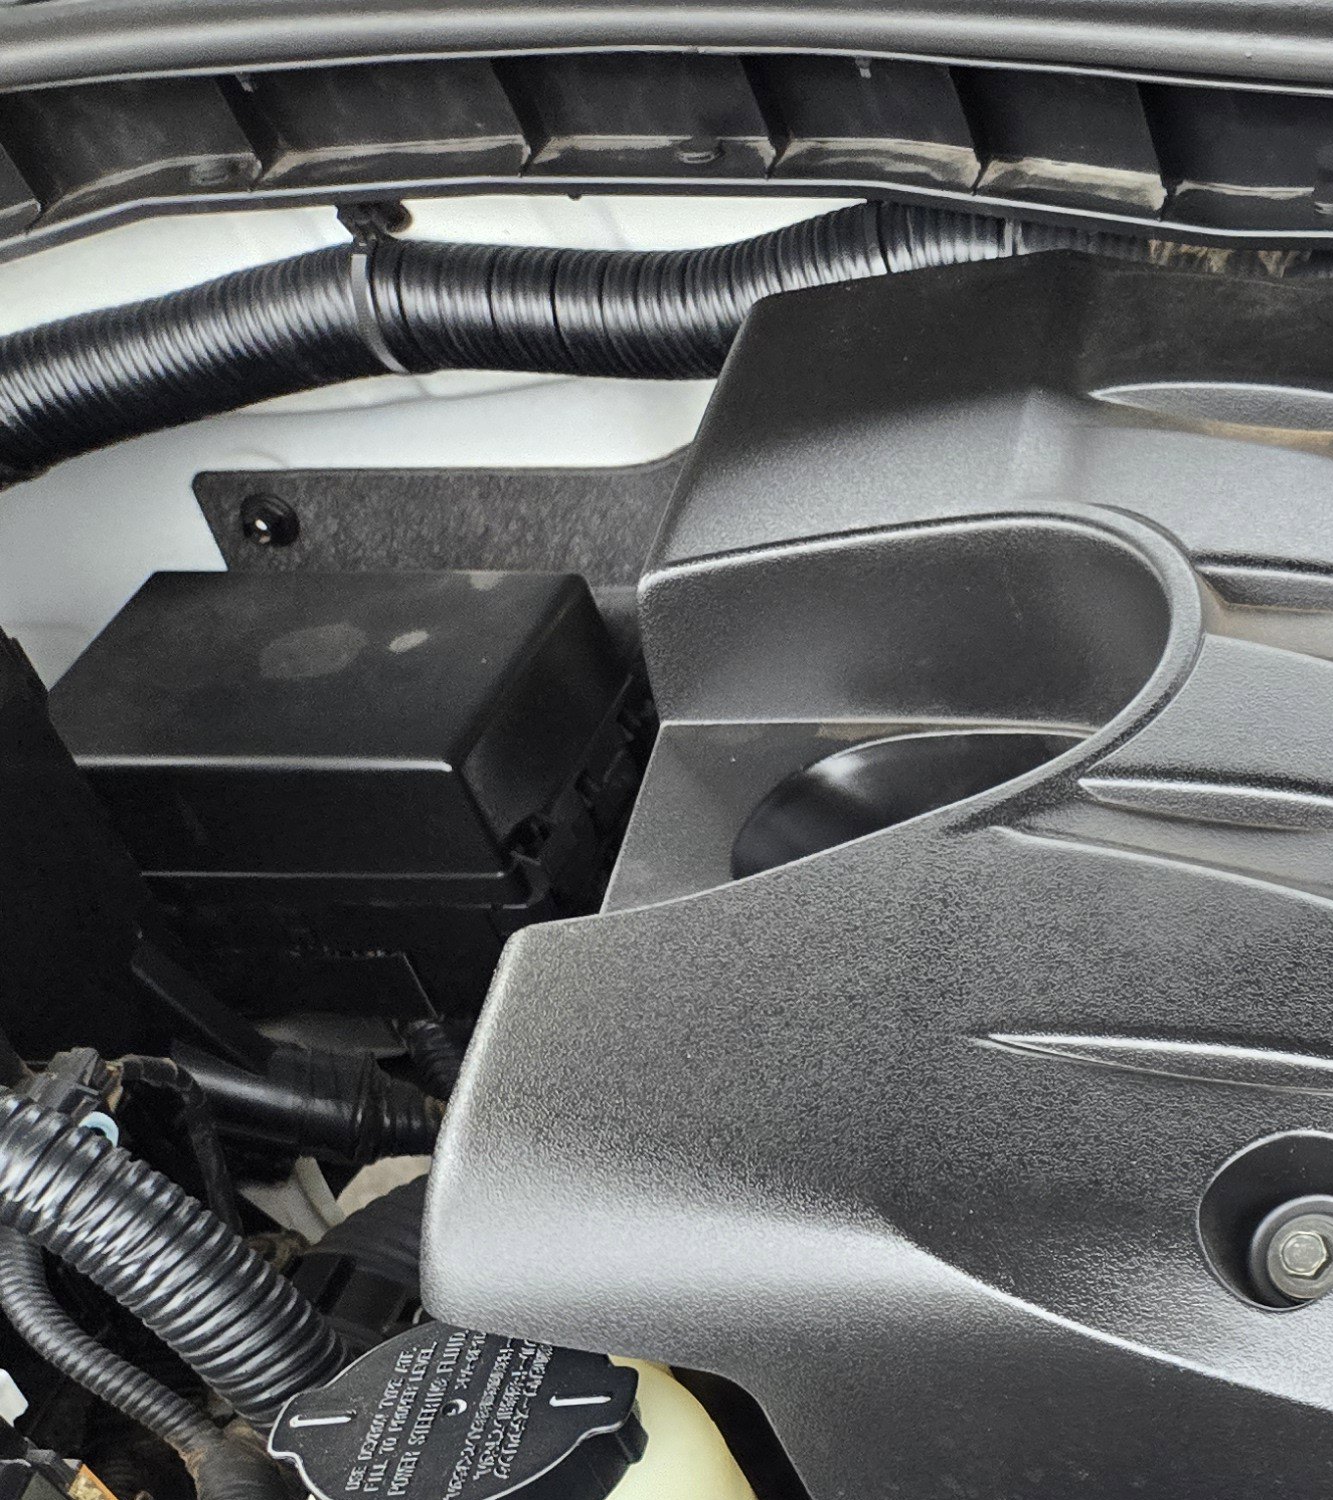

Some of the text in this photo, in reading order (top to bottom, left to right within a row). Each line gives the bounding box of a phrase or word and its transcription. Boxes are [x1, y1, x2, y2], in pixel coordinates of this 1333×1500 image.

[363, 1459, 389, 1492] FILL
[378, 1437, 398, 1454] TO
[387, 1451, 421, 1496] POWER
[407, 1378, 449, 1445] STEERING
